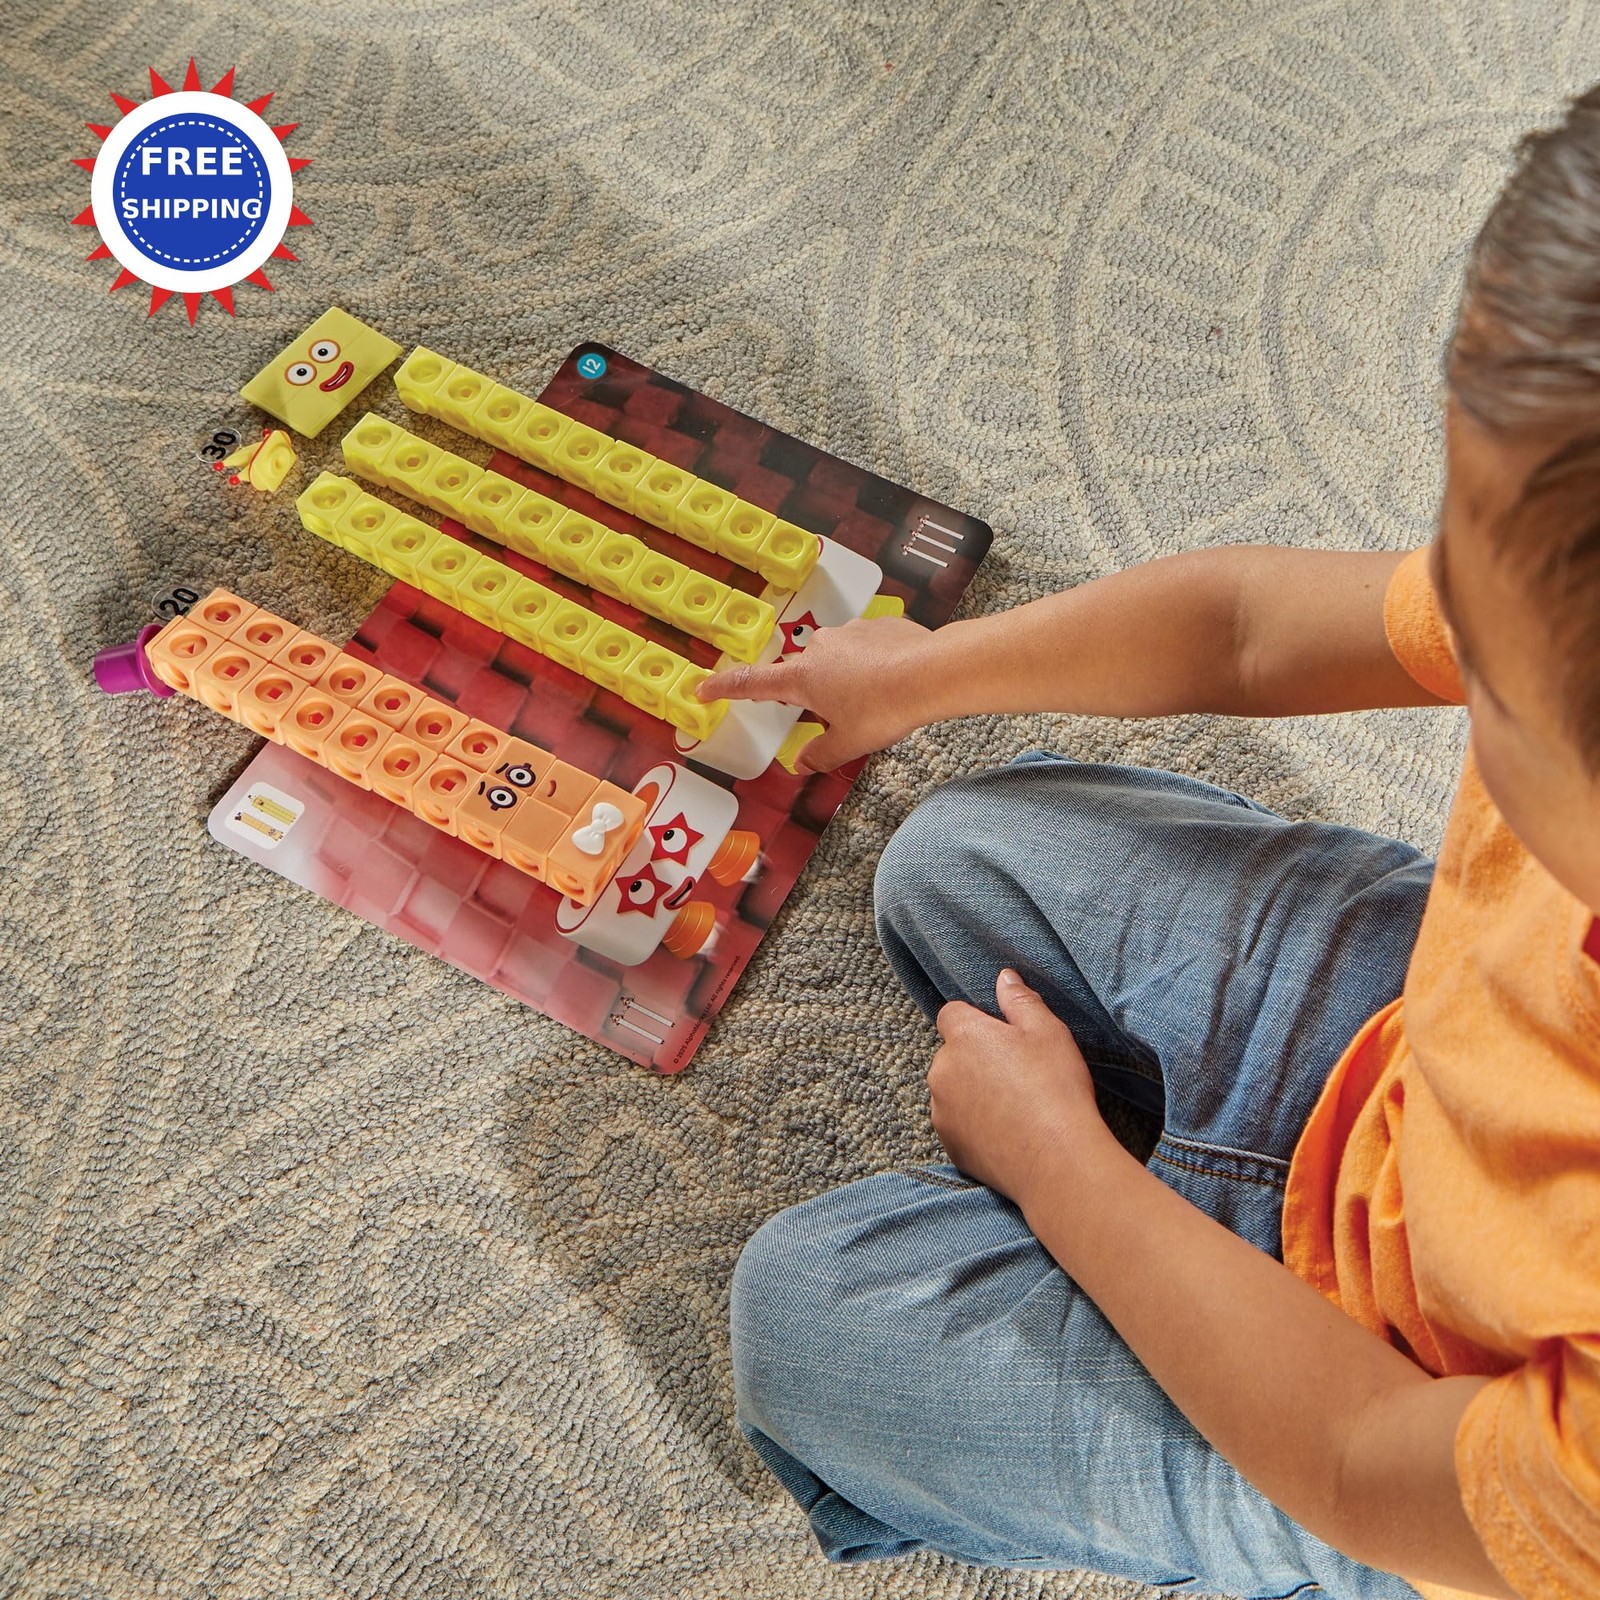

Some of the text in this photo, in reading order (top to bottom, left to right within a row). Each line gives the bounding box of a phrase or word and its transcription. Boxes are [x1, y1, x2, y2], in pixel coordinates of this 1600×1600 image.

[582, 358, 601, 374] 12
[201, 431, 237, 460] 30
[159, 587, 199, 616] 20
